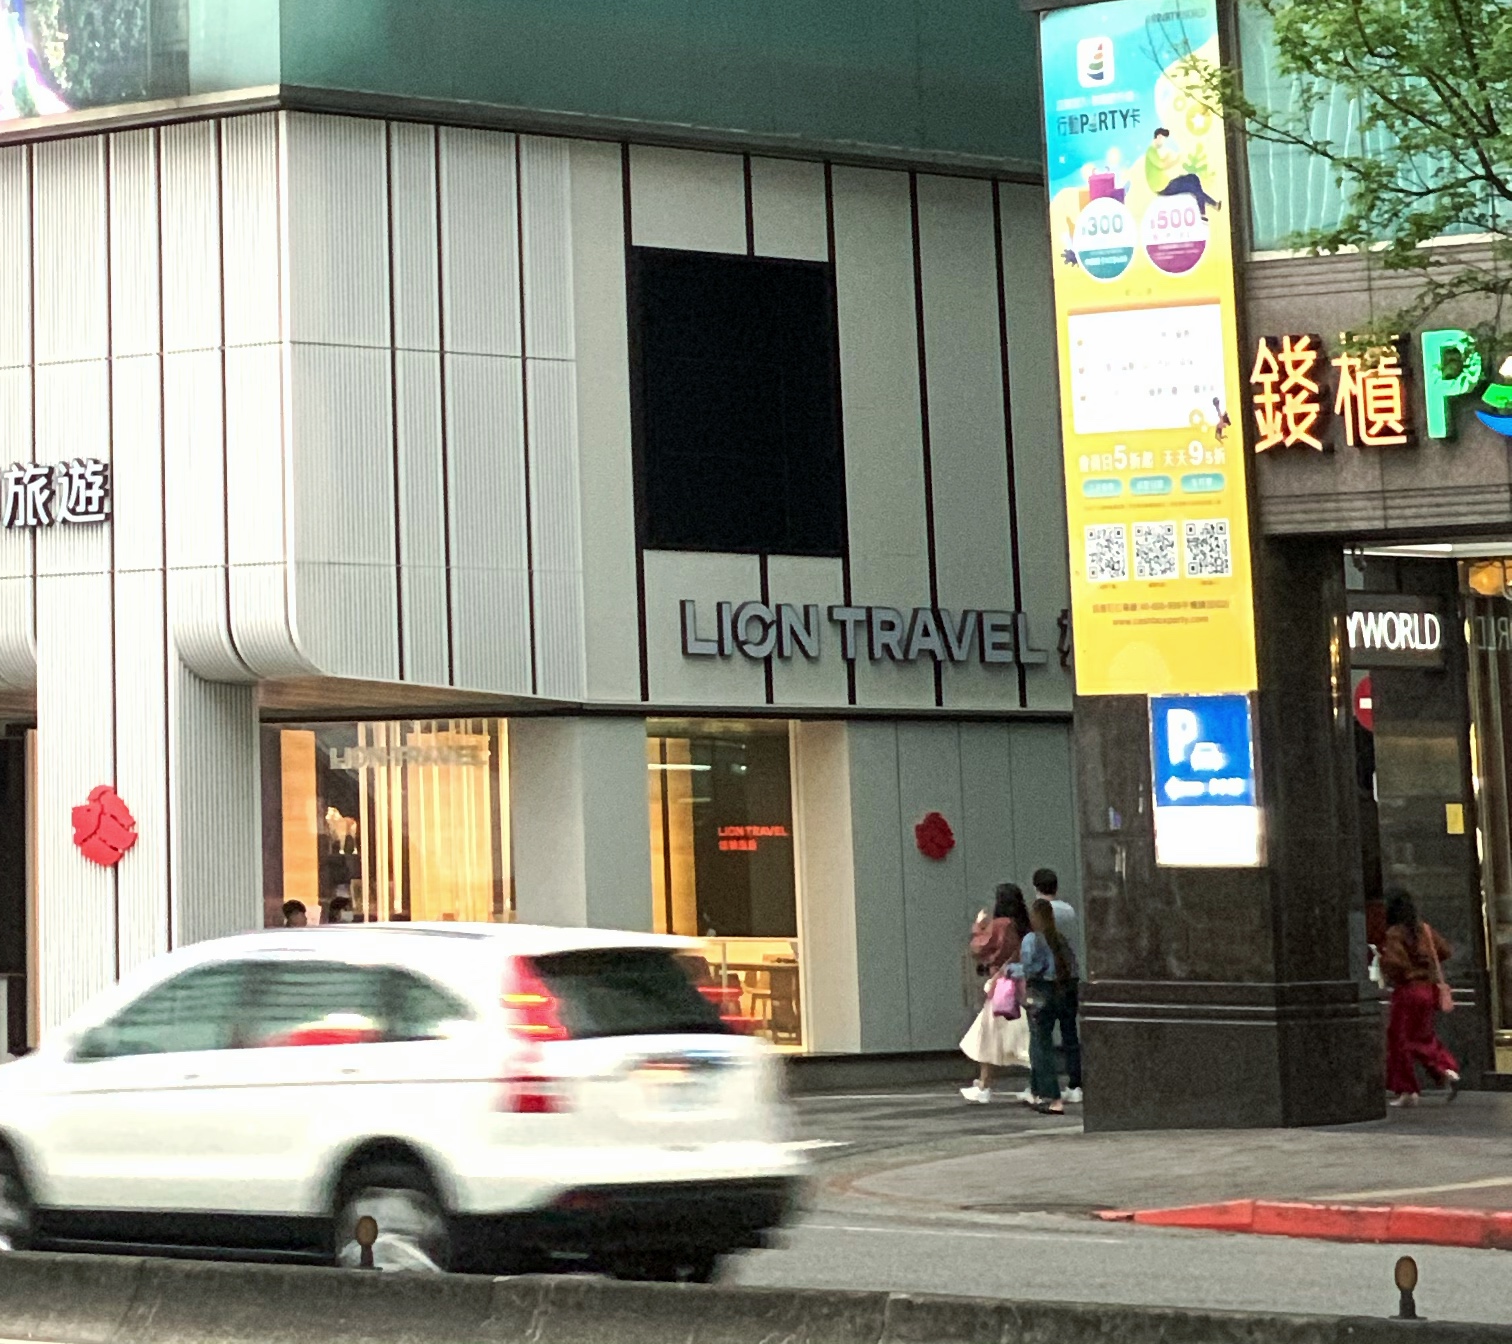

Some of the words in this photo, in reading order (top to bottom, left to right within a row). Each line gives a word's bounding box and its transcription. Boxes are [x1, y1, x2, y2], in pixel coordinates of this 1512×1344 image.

[1250, 331, 1408, 454] 錢櫃
[679, 598, 820, 660] LION
[828, 605, 1050, 664] TRAVEL
